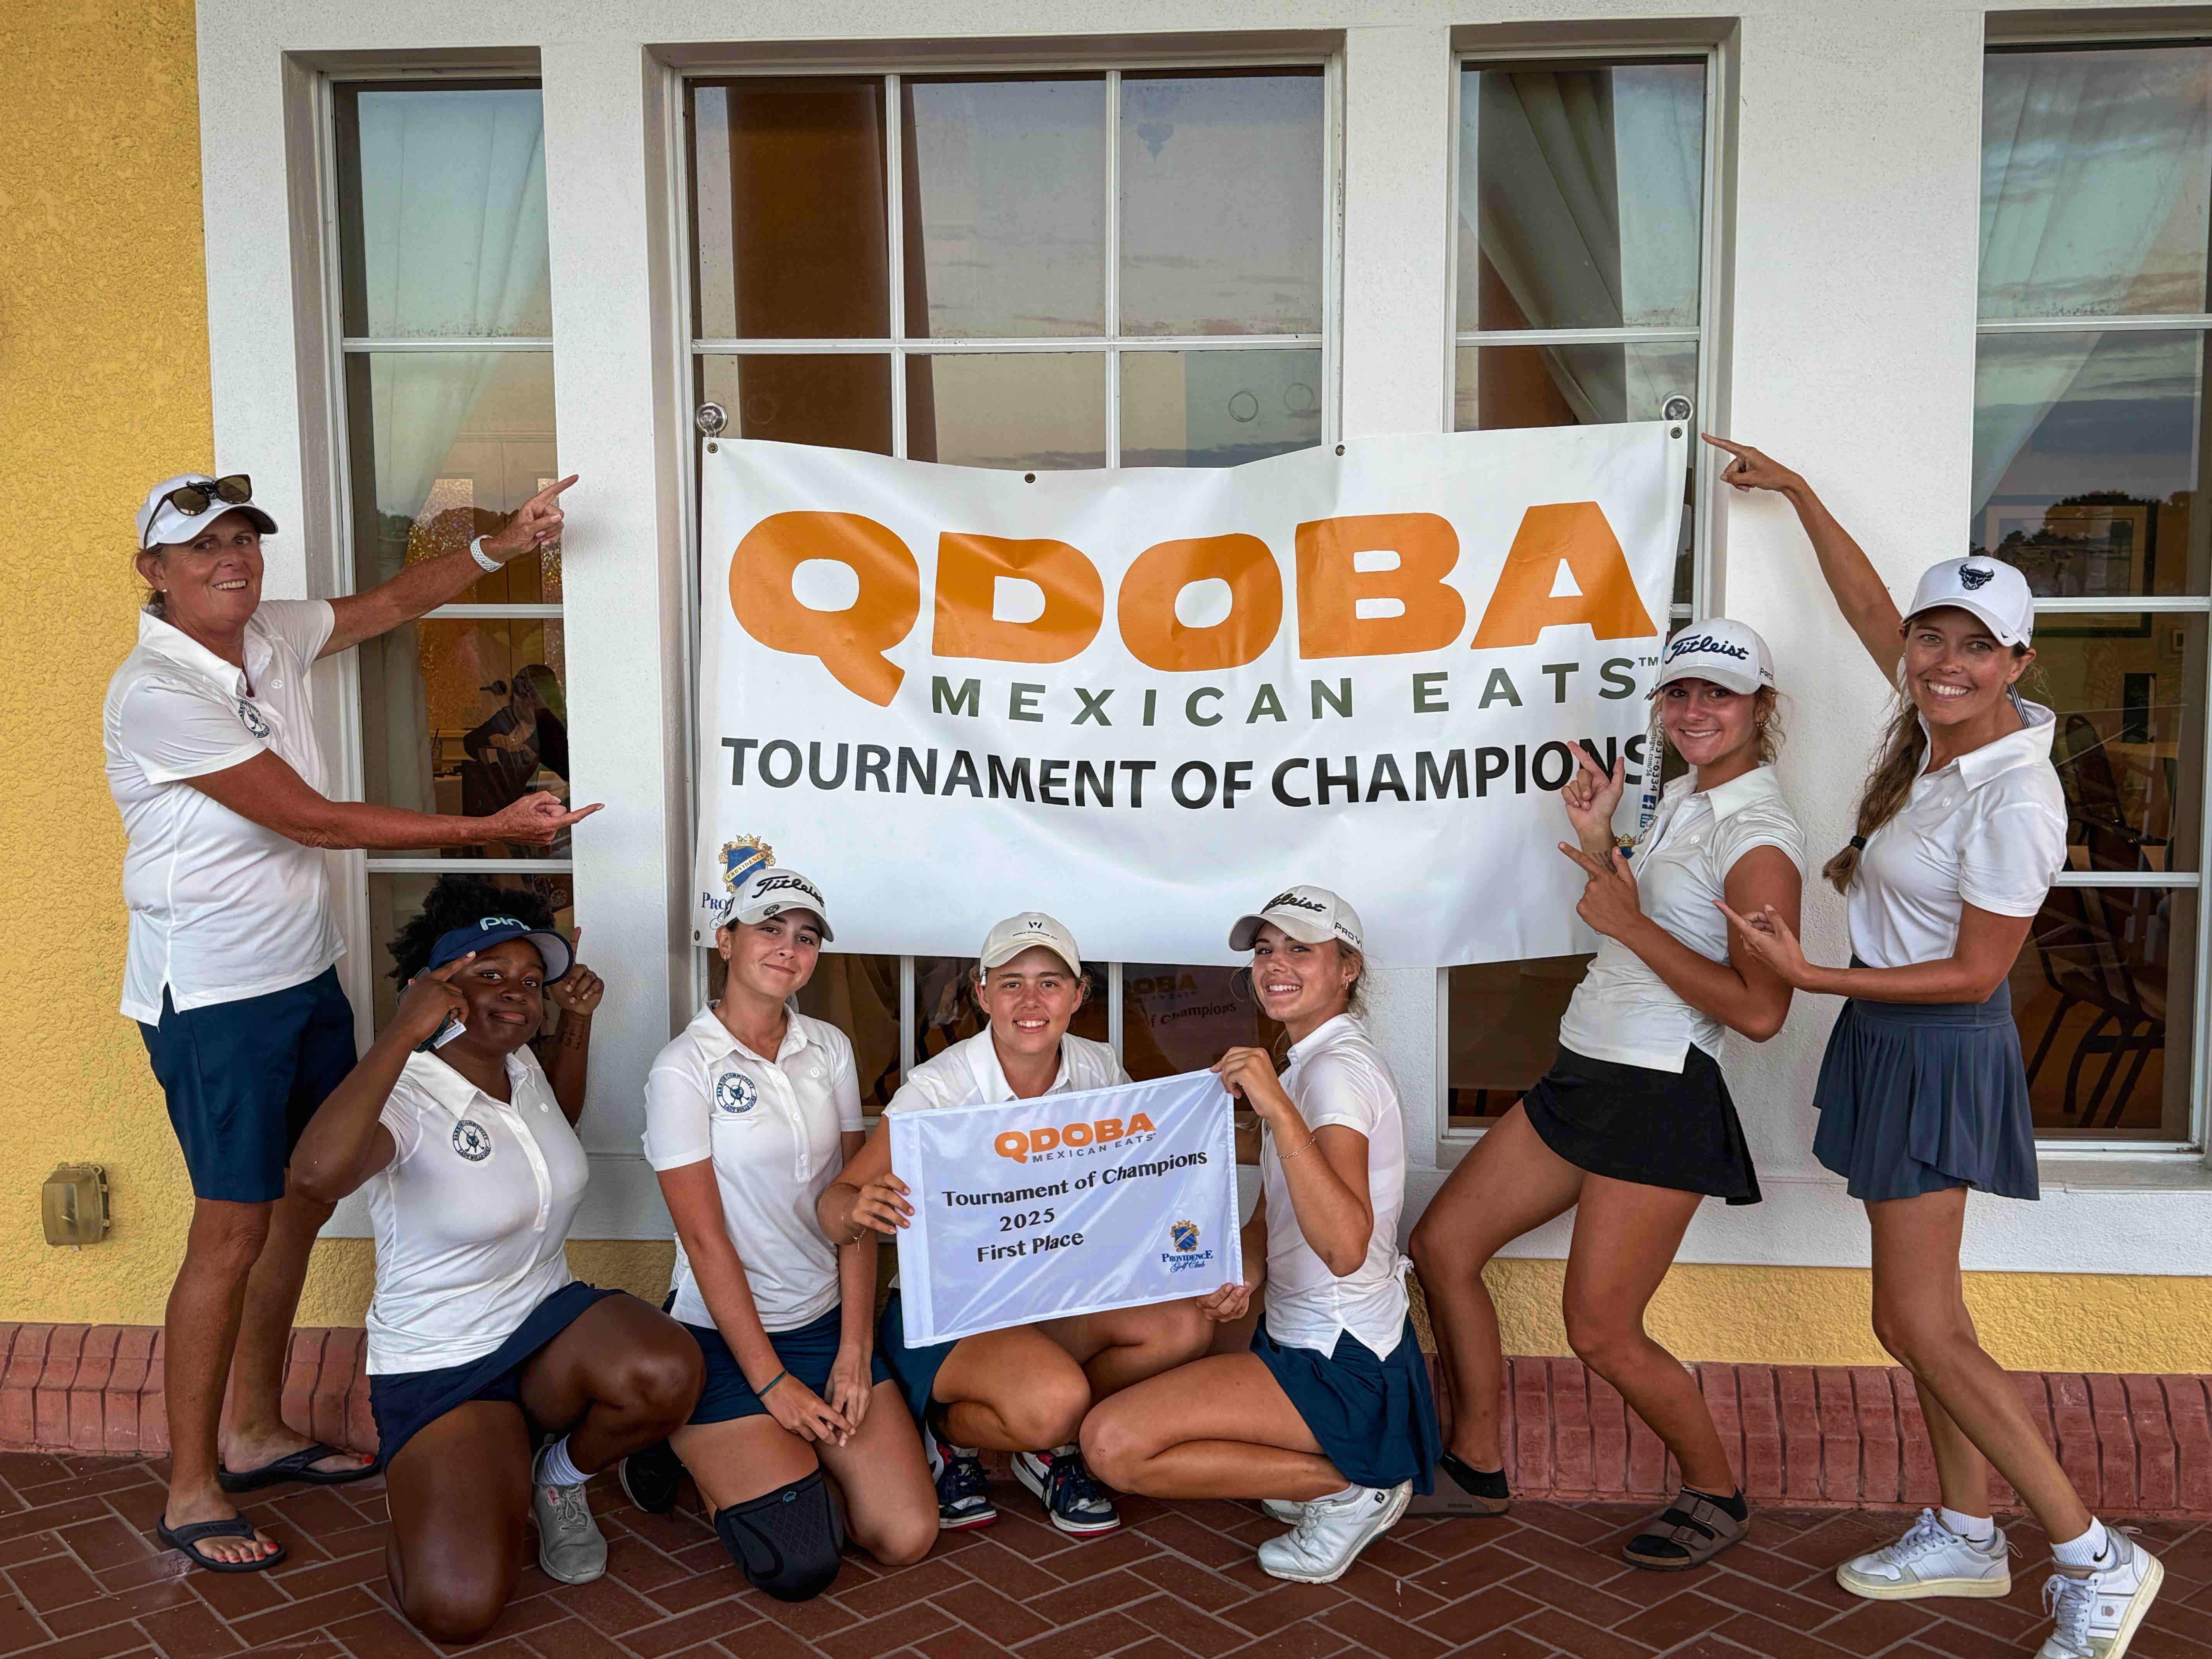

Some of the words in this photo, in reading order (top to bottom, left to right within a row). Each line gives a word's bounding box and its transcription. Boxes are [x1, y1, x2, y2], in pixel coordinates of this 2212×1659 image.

[729, 501, 1657, 707] QDOBA
[1665, 634, 1749, 665] Titleist
[932, 675, 1353, 726] MEXICAN
[1413, 658, 1635, 714] EATS
[1650, 719, 1664, 792] 07-831-6334
[721, 737, 1156, 809] TOURNAMENT
[1171, 761, 1253, 809] OF
[1271, 734, 1647, 807] CHAMPIONS
[1260, 893, 1326, 914] leist
[1334, 922, 1354, 940] PRO
[994, 1113, 1156, 1164] QDOBA
[1032, 1145, 1106, 1163] MEXICAN
[1115, 1133, 1153, 1148] EATS
[942, 1180, 1069, 1206] Tournament
[1075, 1171, 1096, 1190] of
[1102, 1152, 1207, 1185] Champions
[1000, 1208, 1055, 1231] 2025
[977, 1240, 1026, 1262] First
[1032, 1233, 1084, 1254] Place
[1162, 1250, 1213, 1262] PROVIDENCE
[1170, 1261, 1188, 1273] Golf
[1188, 1261, 1206, 1269] Club
